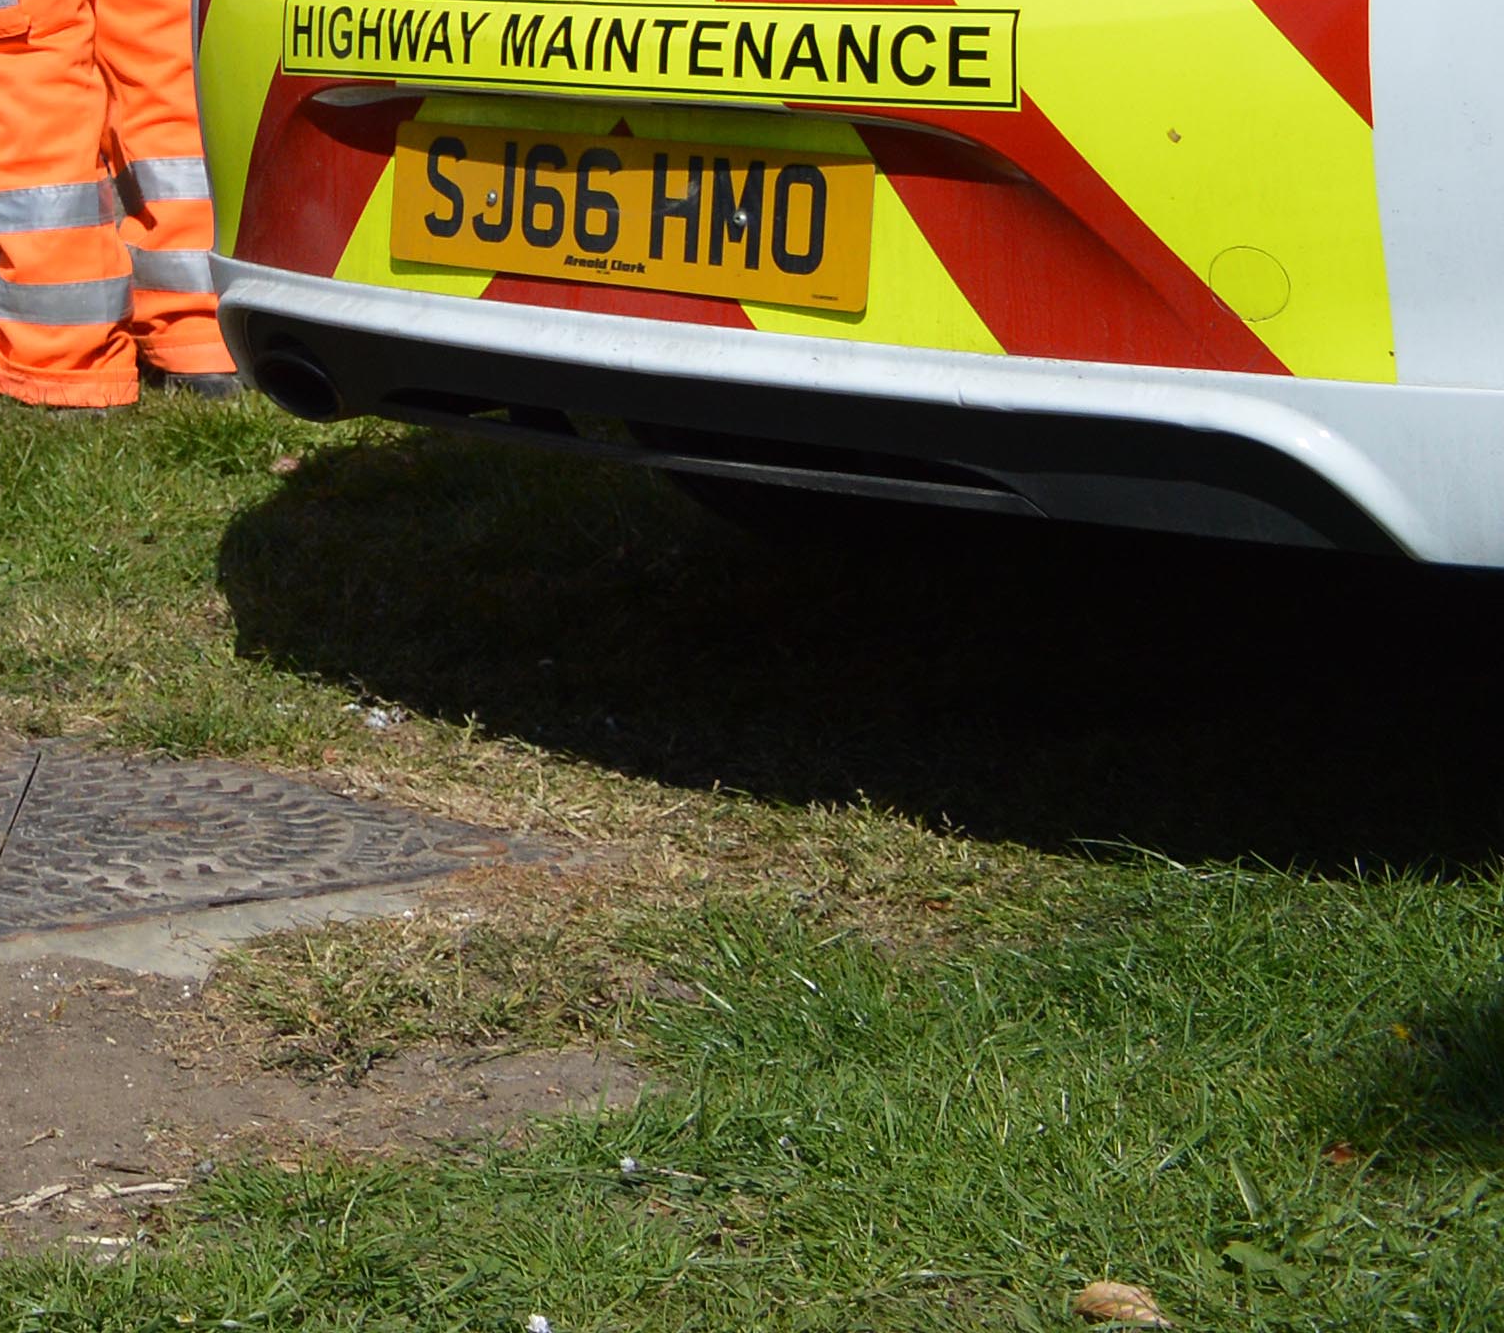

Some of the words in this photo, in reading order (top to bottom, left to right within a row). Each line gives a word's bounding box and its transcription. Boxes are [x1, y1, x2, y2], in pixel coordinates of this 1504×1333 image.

[292, 5, 491, 66] HIGHWAY
[499, 14, 993, 89] MAINTENANCE
[423, 135, 621, 255] SJ66
[649, 151, 828, 276] HMO
[563, 254, 608, 271] Arnold
[610, 258, 646, 274] Clark
